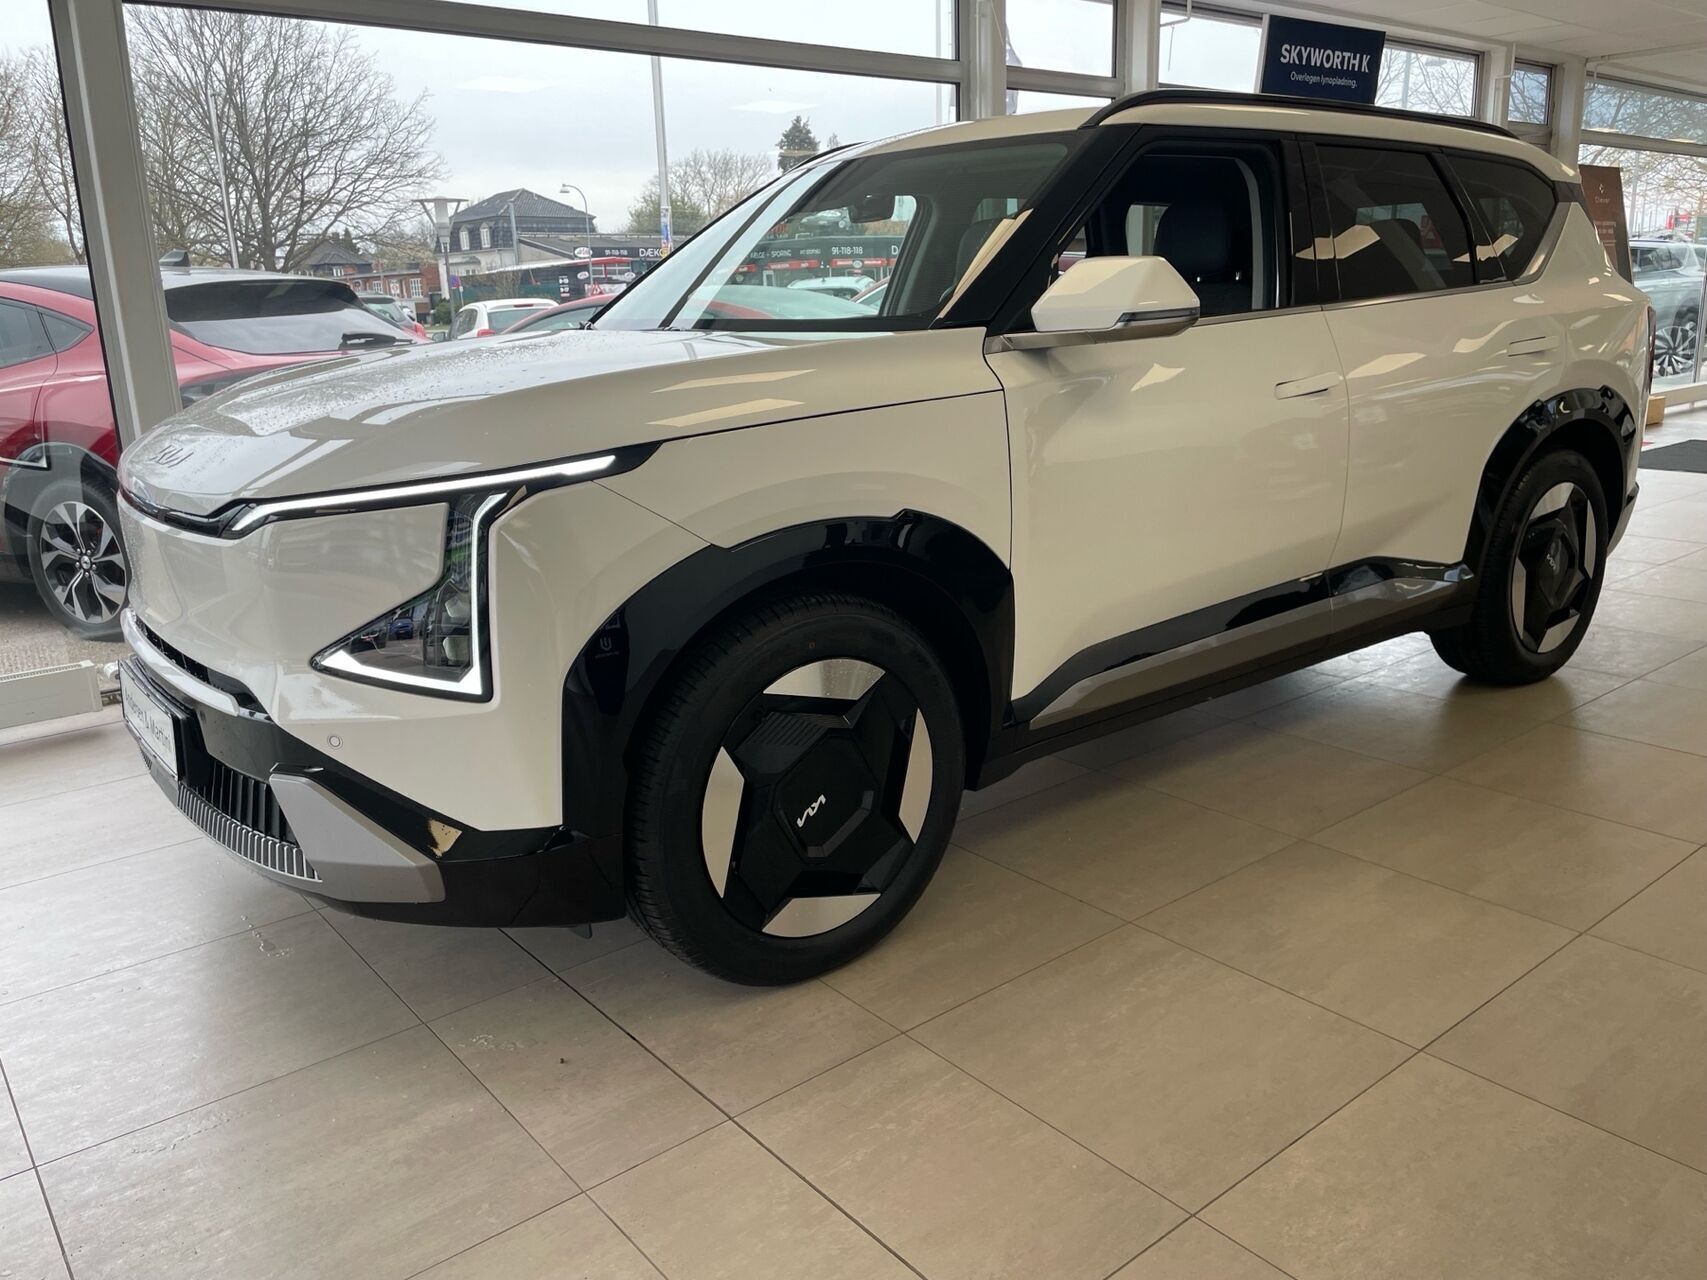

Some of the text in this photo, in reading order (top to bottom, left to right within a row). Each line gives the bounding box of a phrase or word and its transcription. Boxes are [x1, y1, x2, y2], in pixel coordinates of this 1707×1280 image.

[1280, 44, 1371, 73] SKYWORTH K
[1290, 71, 1358, 88] Overlegen lynopladning.
[831, 246, 864, 255] 91-118-118
